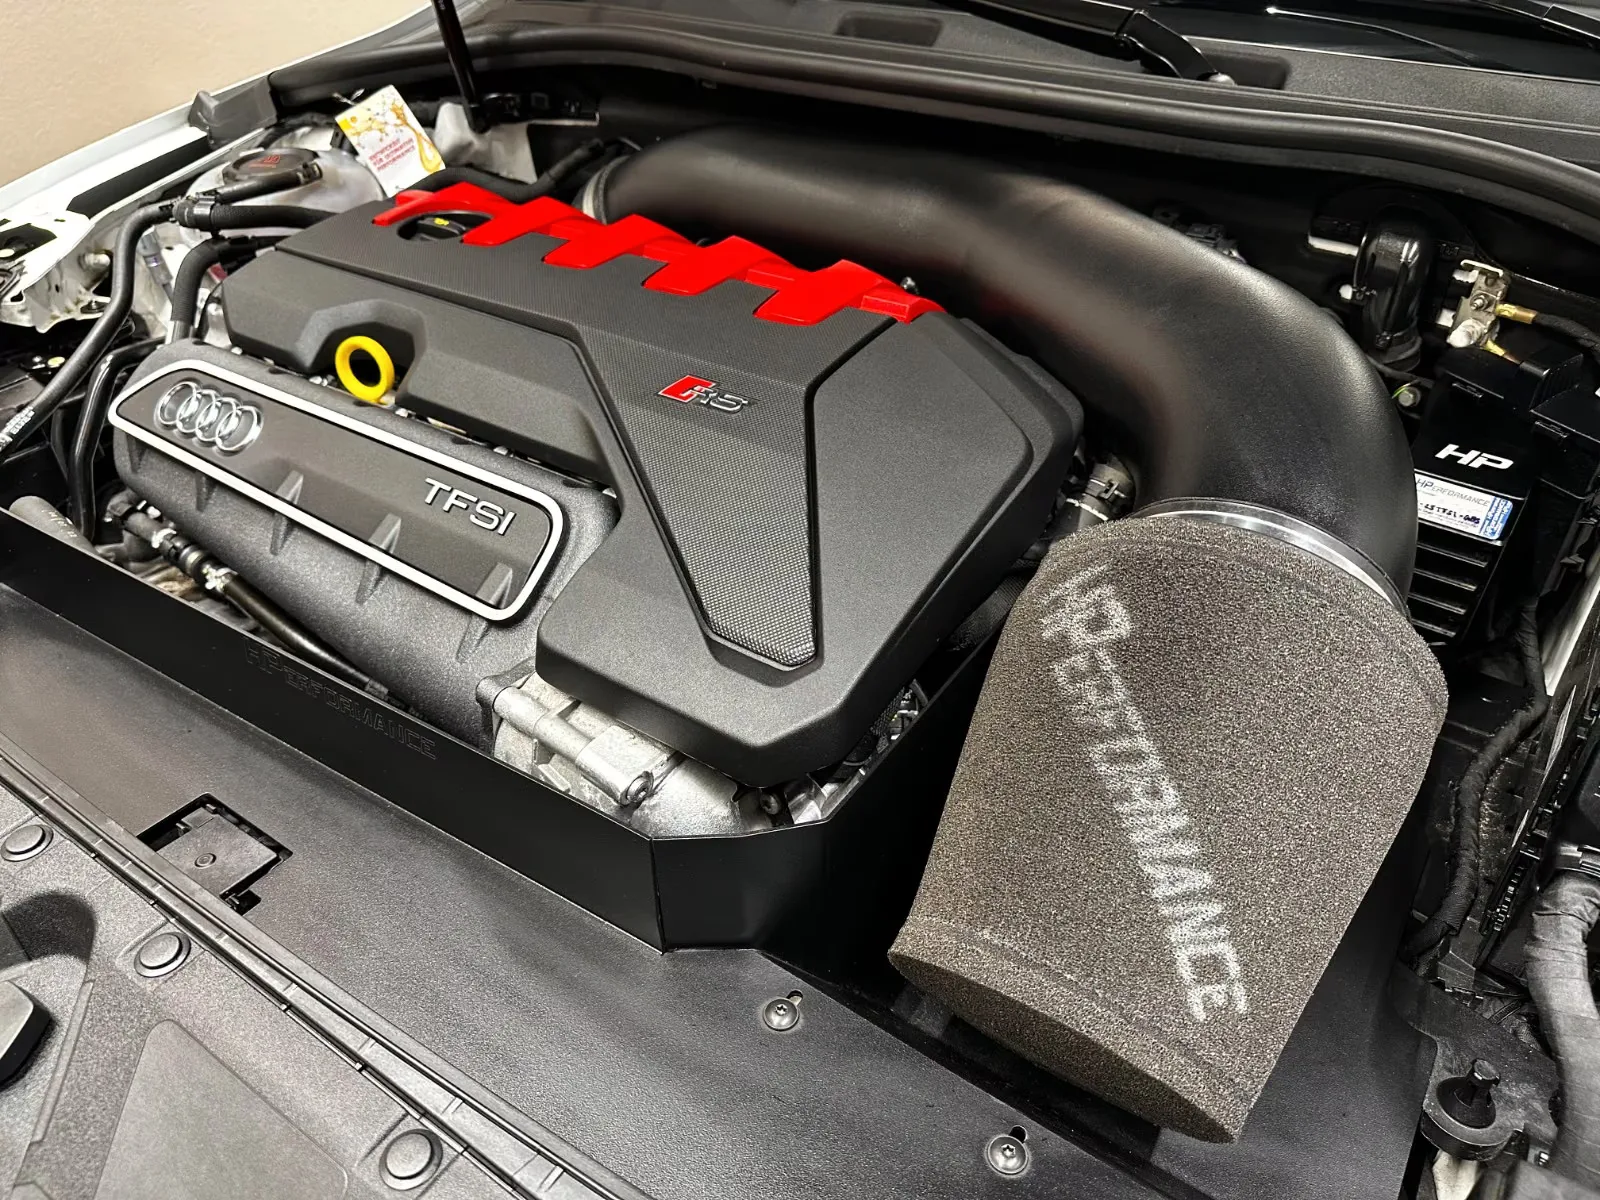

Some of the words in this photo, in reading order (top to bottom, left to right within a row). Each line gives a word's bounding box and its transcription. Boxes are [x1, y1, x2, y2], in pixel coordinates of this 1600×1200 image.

[657, 374, 749, 411] RS
[1435, 443, 1514, 470] HP
[425, 477, 517, 536] TFSI
